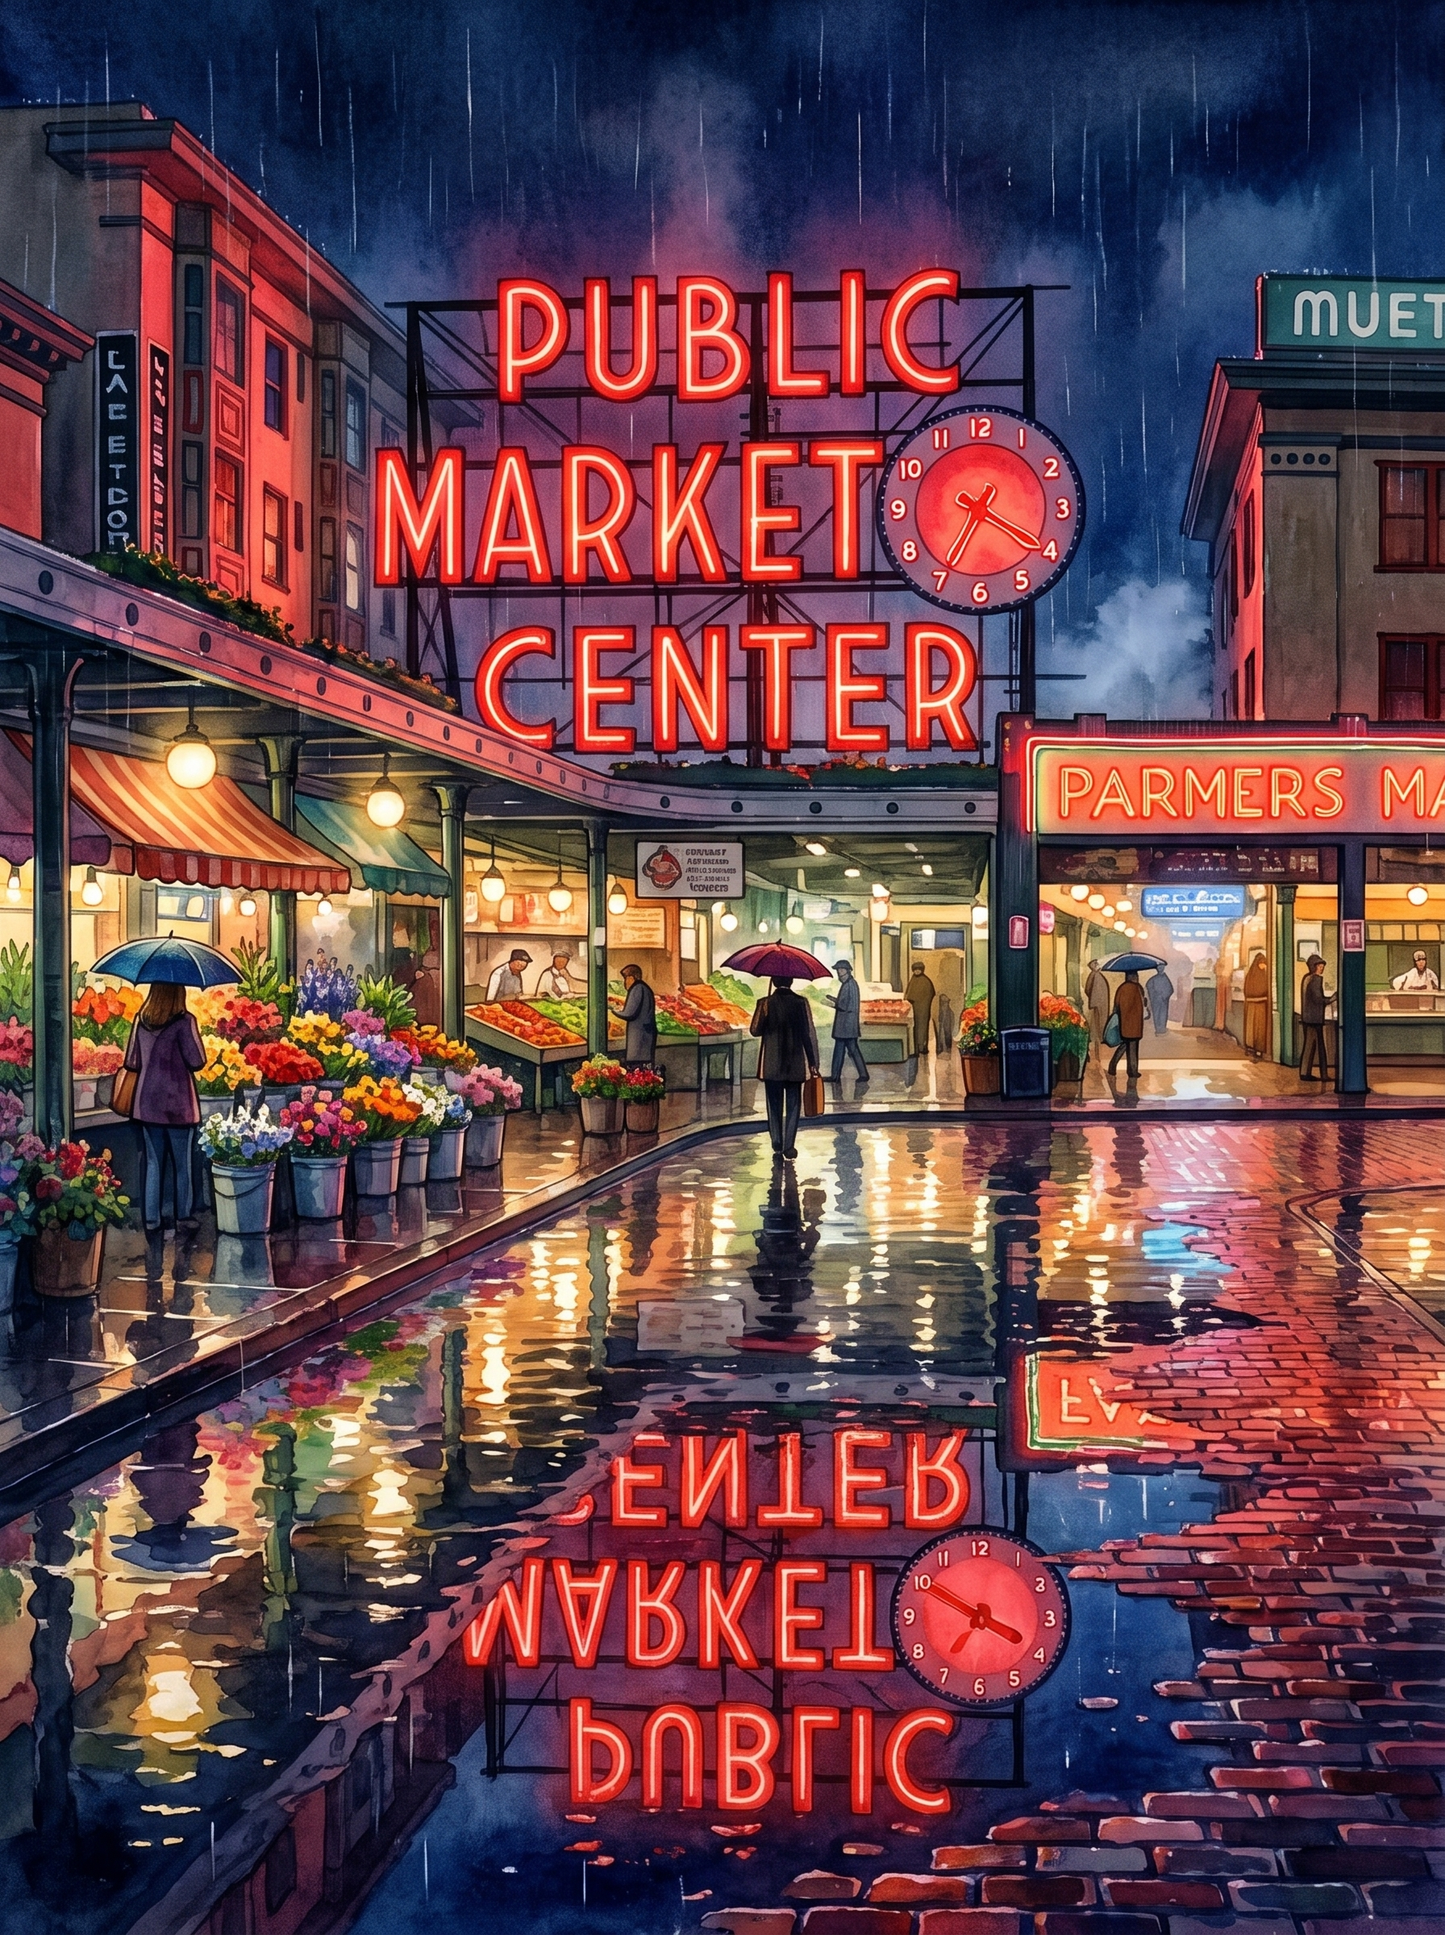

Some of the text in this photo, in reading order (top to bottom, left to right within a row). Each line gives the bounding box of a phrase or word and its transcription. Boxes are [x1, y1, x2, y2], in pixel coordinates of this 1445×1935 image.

[1293, 289, 1445, 339] MUET
[498, 268, 960, 403] PUBLIC
[971, 417, 991, 437] 12
[934, 429, 948, 448] 11
[1018, 428, 1024, 447] 1
[901, 459, 922, 479] 10
[1044, 458, 1059, 477] 2
[375, 440, 885, 585] MARKET
[890, 500, 906, 519] 9
[1056, 498, 1070, 518] 3
[902, 541, 917, 561] 8
[1043, 540, 1058, 560] 4
[932, 571, 948, 590] 7
[1015, 570, 1029, 590] 5
[972, 582, 988, 602] 6
[475, 623, 976, 753] CENTER
[1059, 766, 1344, 818] PARMERS
[971, 1540, 989, 1557] 12
[938, 1550, 949, 1567] 11
[1015, 1551, 1020, 1567] 1
[914, 1574, 932, 1591] 10
[903, 1608, 916, 1625] 9
[1043, 1610, 1056, 1627] 3
[912, 1643, 924, 1659] 8
[1033, 1647, 1045, 1663] 4
[939, 1667, 949, 1684] 7
[1008, 1671, 1020, 1687] 5
[973, 1678, 985, 1696] 6
